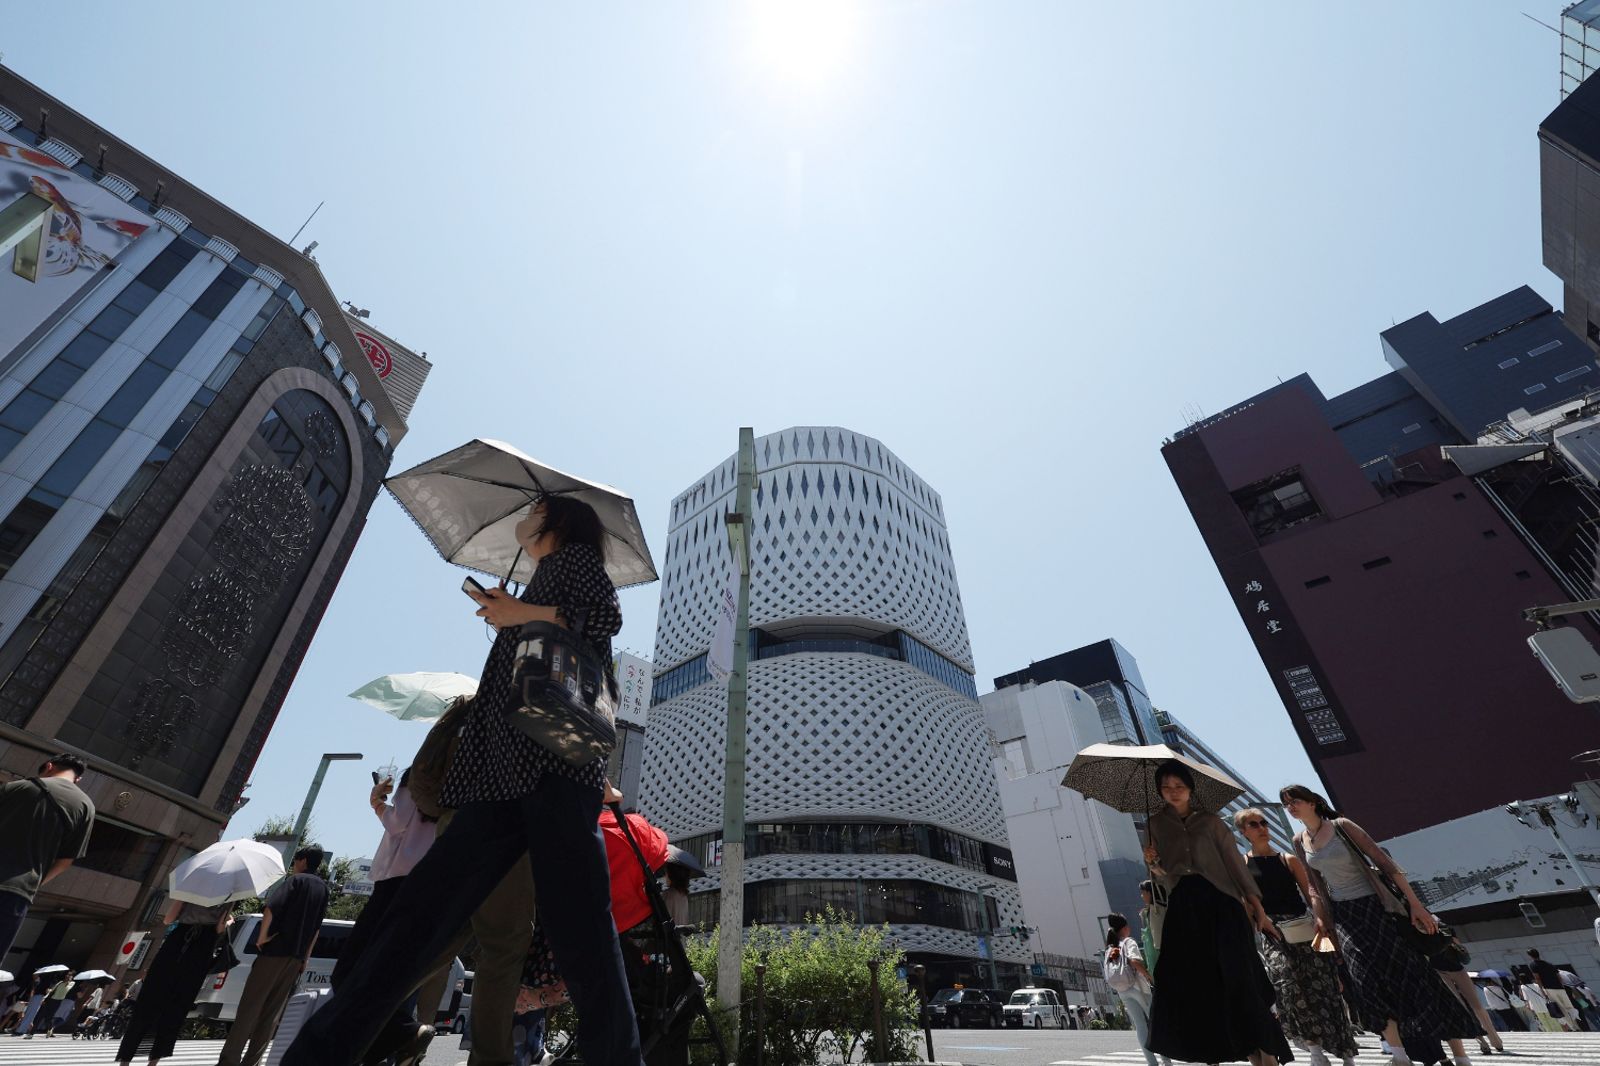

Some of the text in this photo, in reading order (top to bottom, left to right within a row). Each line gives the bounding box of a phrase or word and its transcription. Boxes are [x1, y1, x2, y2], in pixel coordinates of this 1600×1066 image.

[1245, 580, 1282, 634] 鳩居堂
[993, 856, 1011, 869] SONY
[306, 970, 331, 984] TOK
